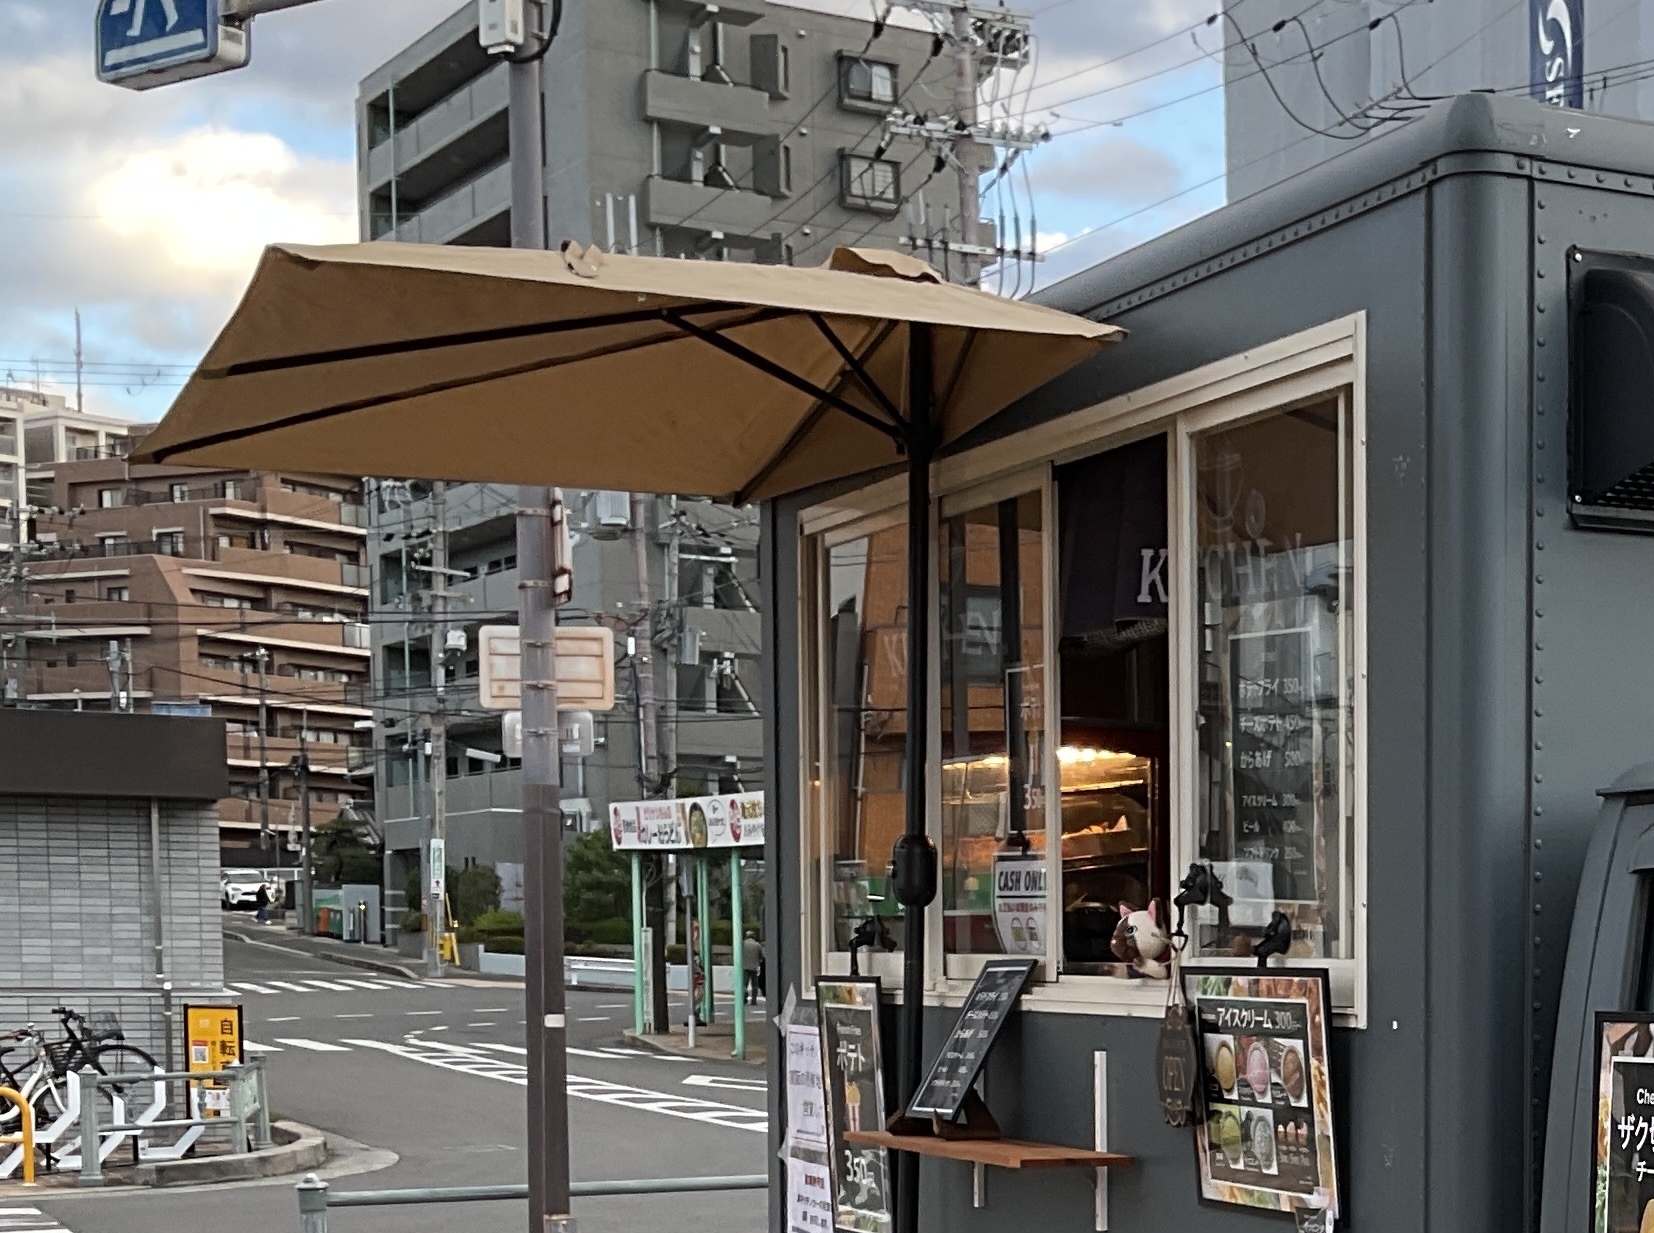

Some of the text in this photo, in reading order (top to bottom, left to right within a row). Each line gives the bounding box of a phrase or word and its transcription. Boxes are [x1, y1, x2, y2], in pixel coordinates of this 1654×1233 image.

[998, 870, 1021, 892] CASH
[1217, 1007, 1273, 1030] アイスクリーム
